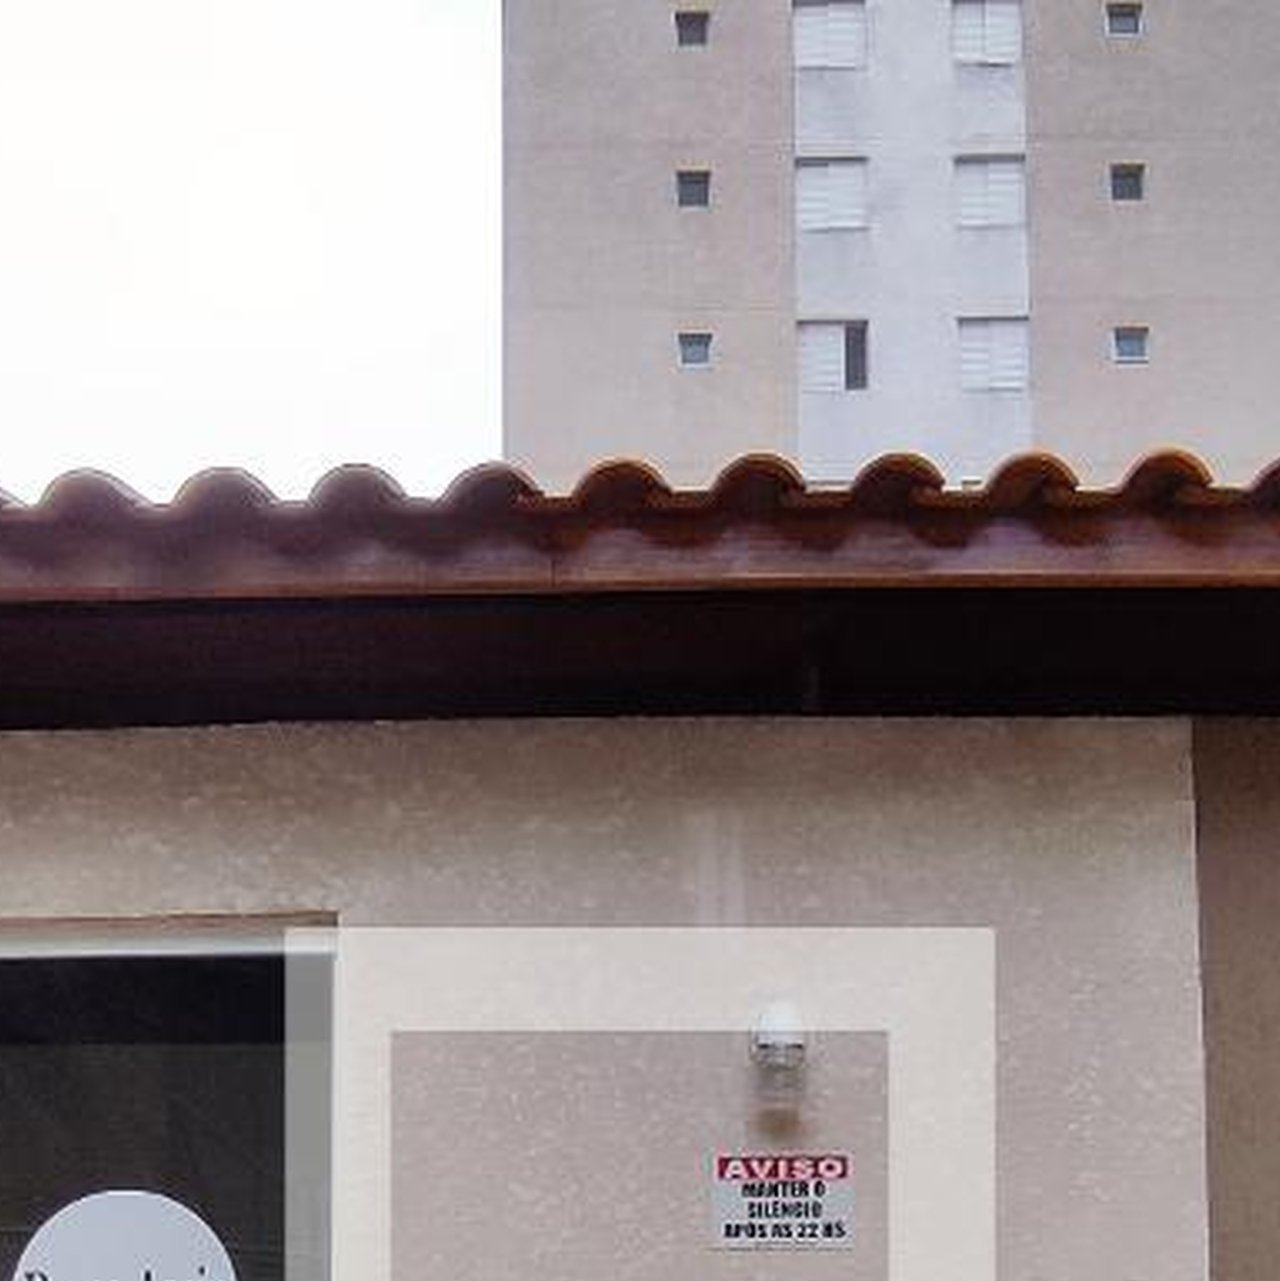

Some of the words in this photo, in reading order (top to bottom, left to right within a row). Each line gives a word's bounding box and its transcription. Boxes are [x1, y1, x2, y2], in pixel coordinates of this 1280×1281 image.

[724, 1158, 844, 1178] AVISO
[741, 1181, 810, 1198] MANTER
[813, 1180, 826, 1198] O
[796, 1223, 819, 1238] 22
